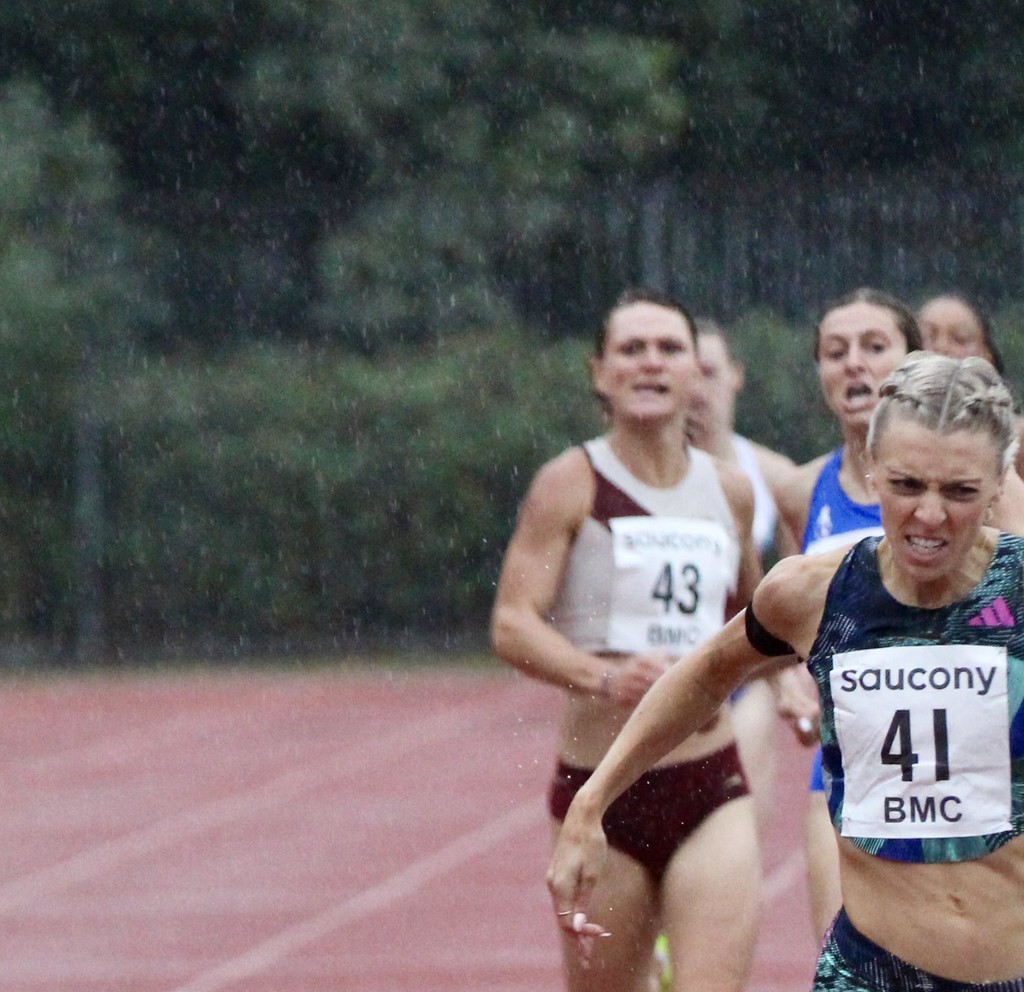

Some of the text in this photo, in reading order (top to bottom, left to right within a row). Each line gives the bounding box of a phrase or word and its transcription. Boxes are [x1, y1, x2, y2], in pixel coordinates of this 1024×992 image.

[652, 562, 700, 614] 43
[841, 666, 997, 696] saucony
[881, 708, 950, 782] 41
[884, 796, 962, 824] BMC
